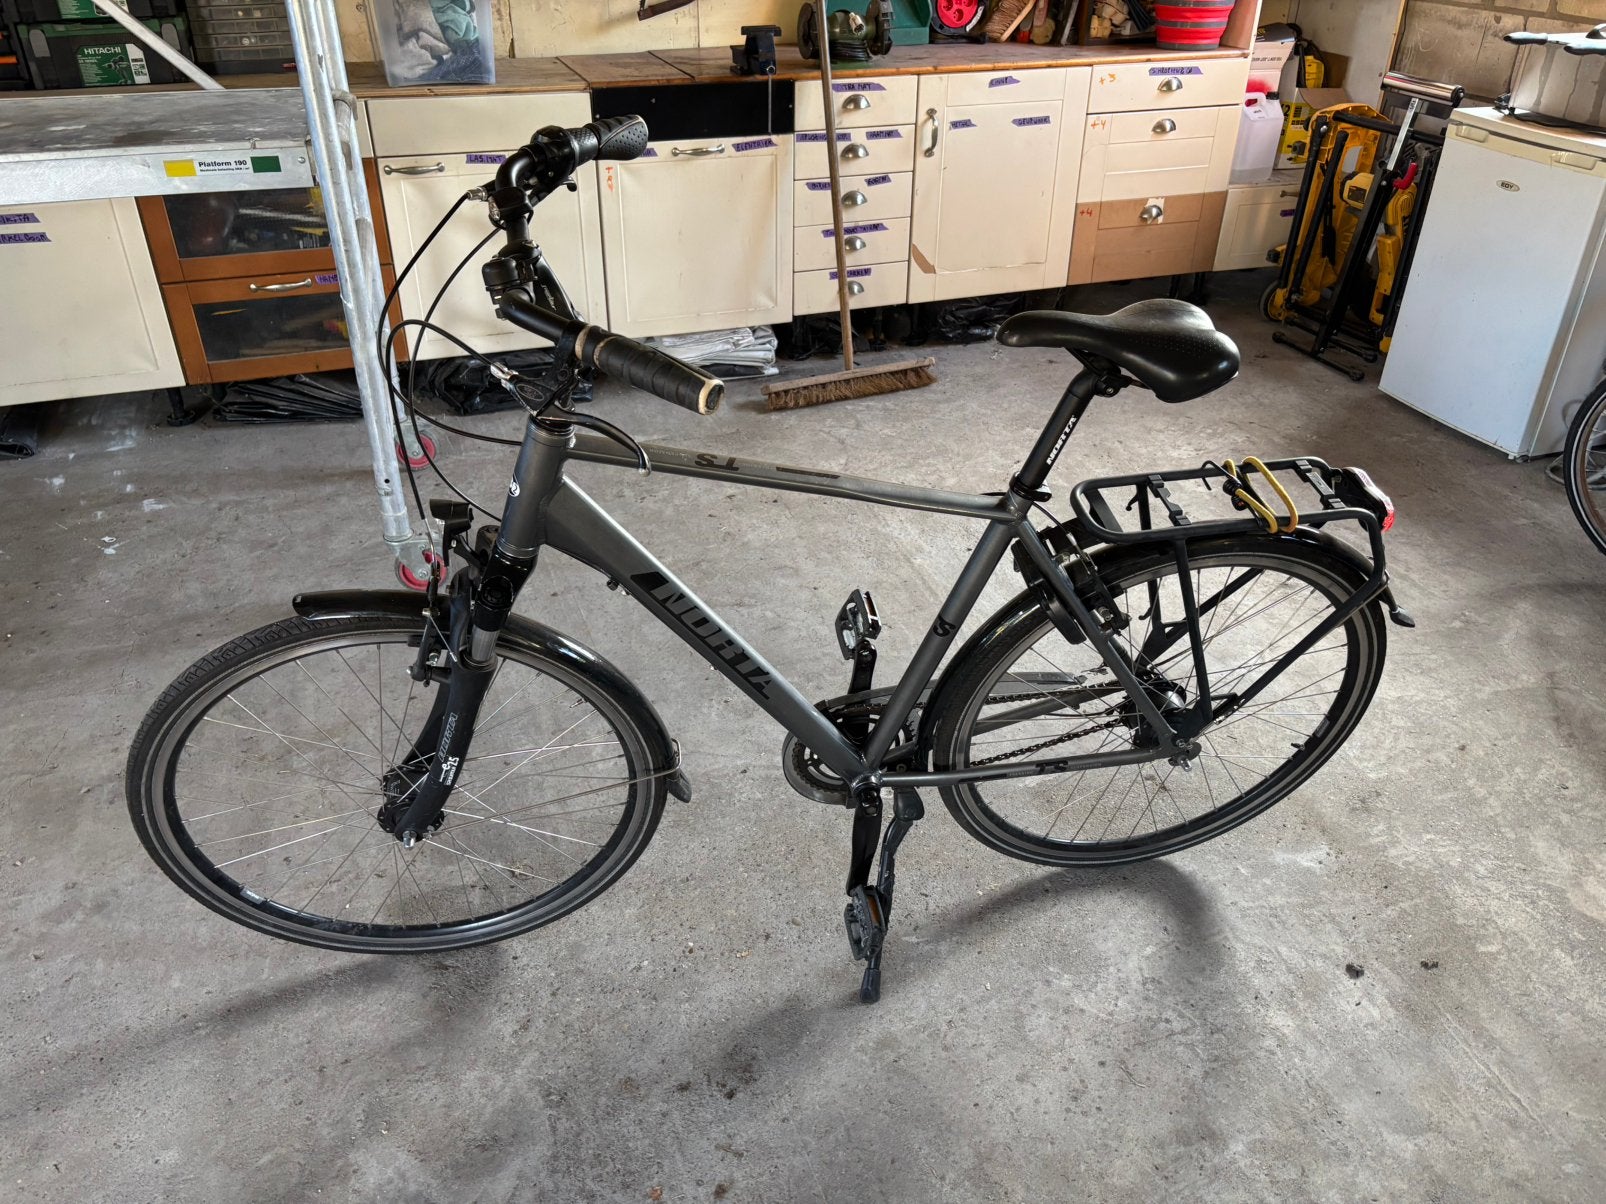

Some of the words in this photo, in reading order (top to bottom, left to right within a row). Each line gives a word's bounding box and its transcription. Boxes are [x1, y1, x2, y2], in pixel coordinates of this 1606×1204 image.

[84, 46, 121, 55] HITACHI
[198, 160, 232, 168] Platform
[1046, 415, 1077, 465] NORTA
[640, 575, 772, 700] NORTA
